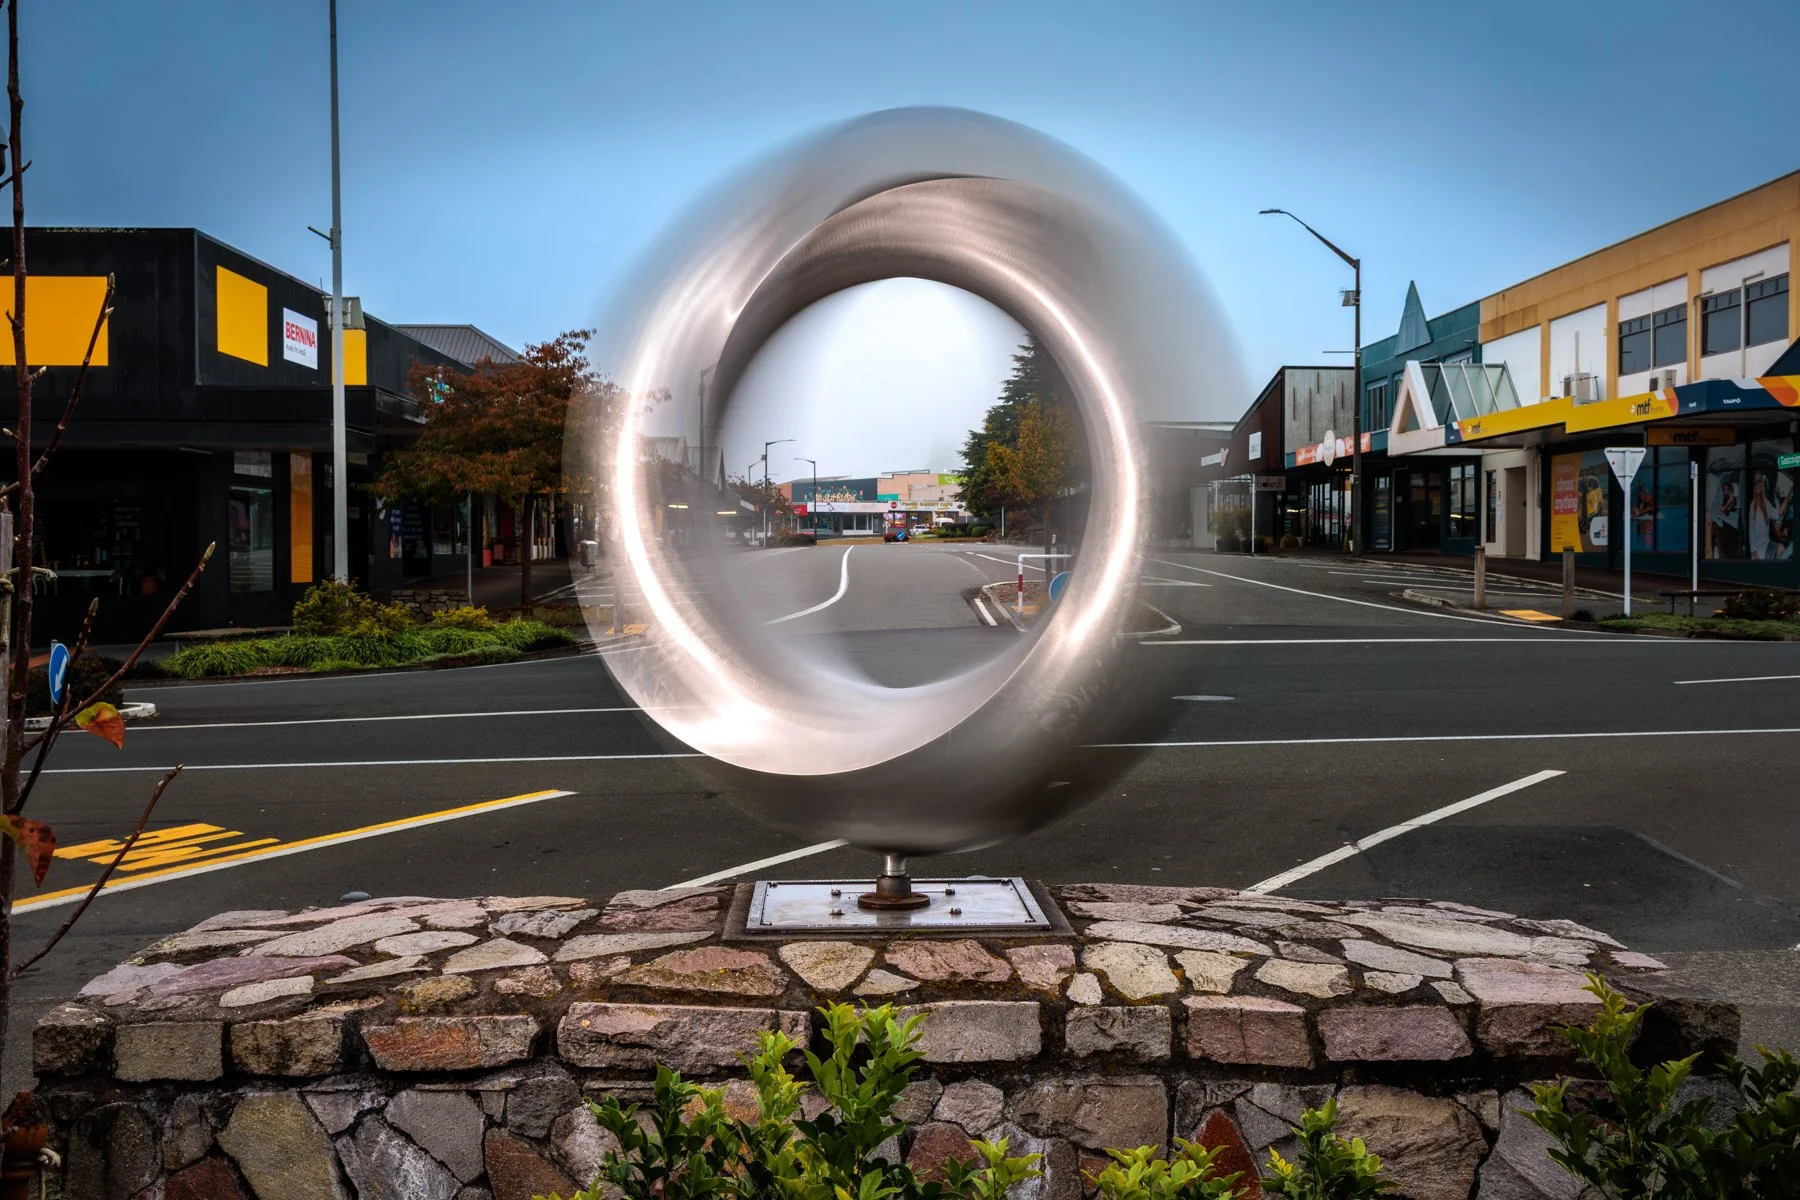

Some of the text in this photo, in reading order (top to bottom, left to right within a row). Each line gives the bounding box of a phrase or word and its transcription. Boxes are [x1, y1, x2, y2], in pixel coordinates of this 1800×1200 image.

[286, 320, 316, 349] BERNINA
[1636, 398, 1651, 416] mtf
[1673, 430, 1699, 443] mtf
[1556, 477, 1575, 491] almost
[1554, 494, 1578, 513] anything
